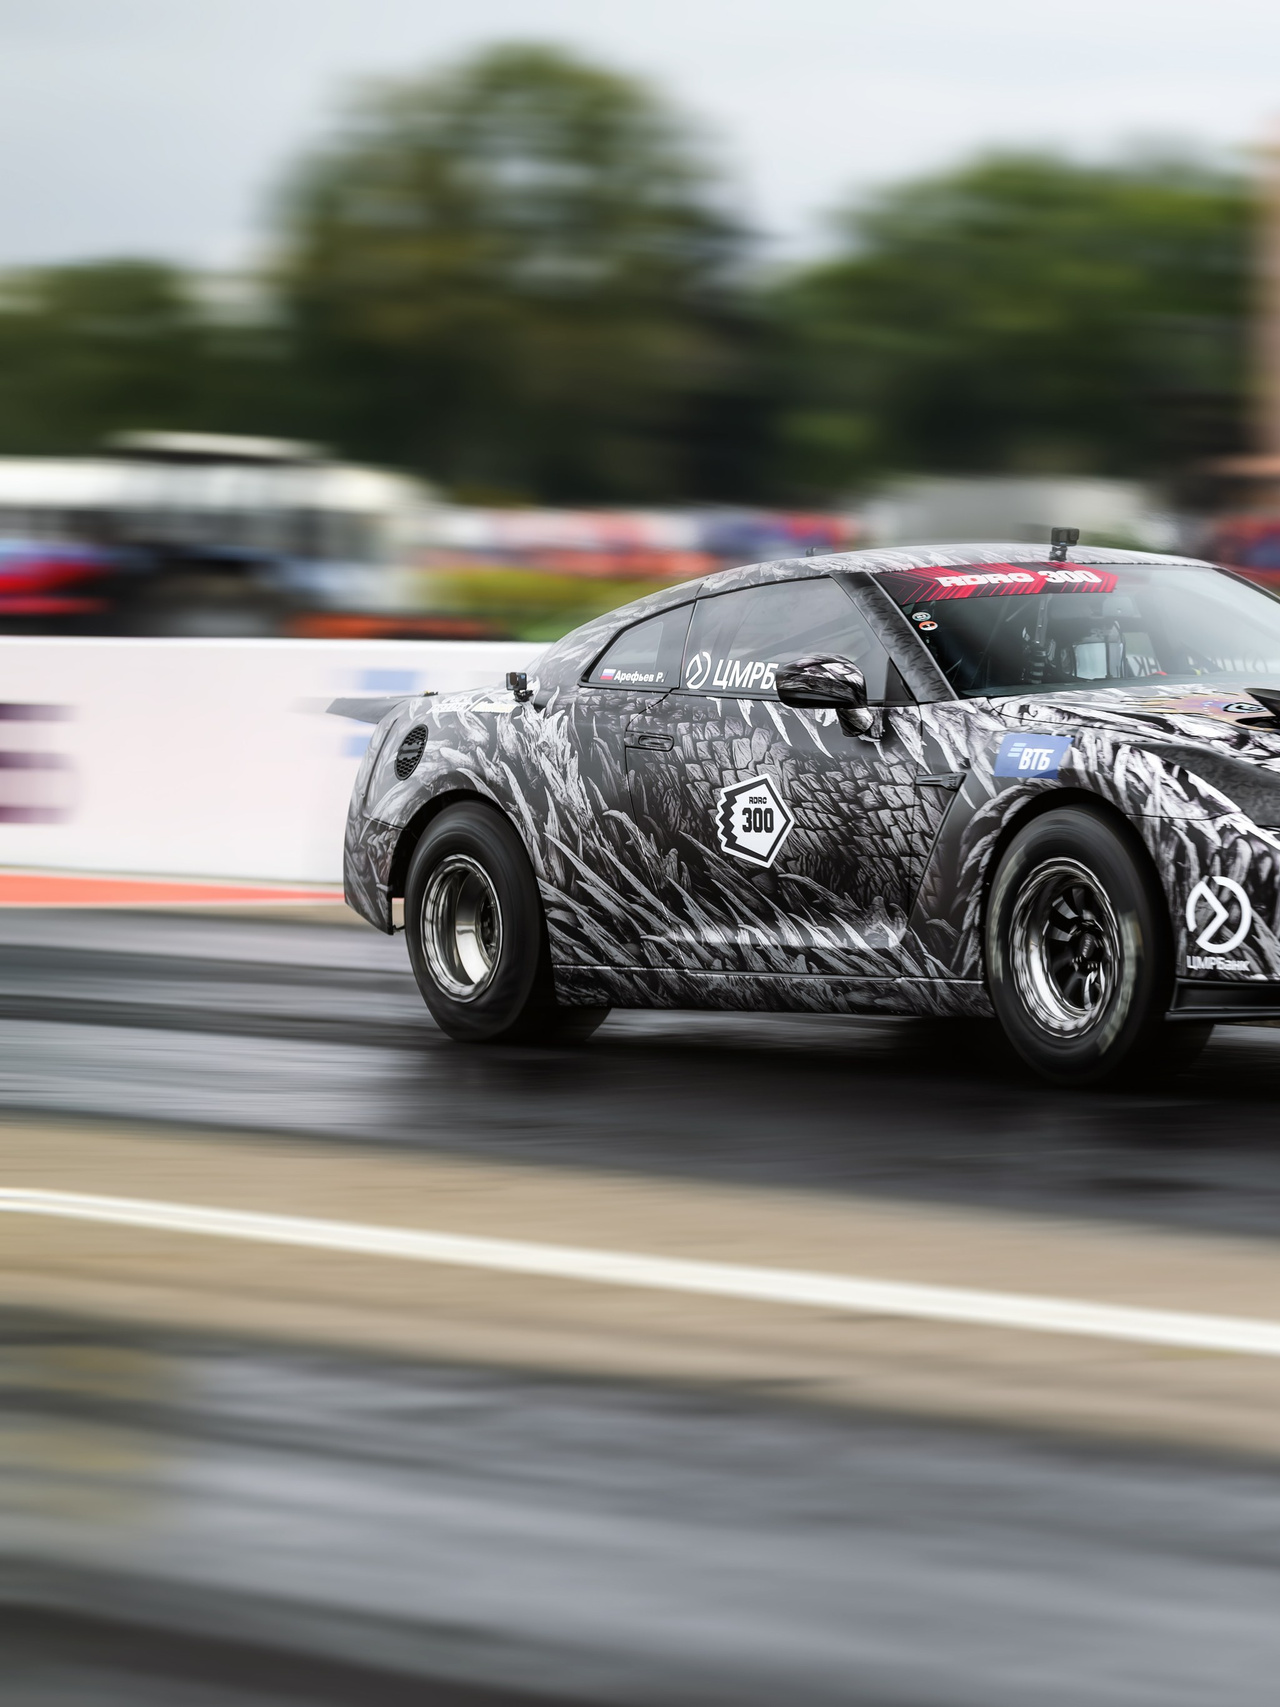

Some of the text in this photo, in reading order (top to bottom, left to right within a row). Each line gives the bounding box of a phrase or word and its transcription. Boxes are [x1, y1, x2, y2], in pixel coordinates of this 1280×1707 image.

[935, 570, 1102, 587] RDRC 300
[613, 670, 653, 683] Арефьев
[712, 660, 778, 690] ЦМРБ
[1018, 747, 1055, 770] ВТБ
[748, 796, 767, 804] RDRC
[742, 807, 774, 833] 300
